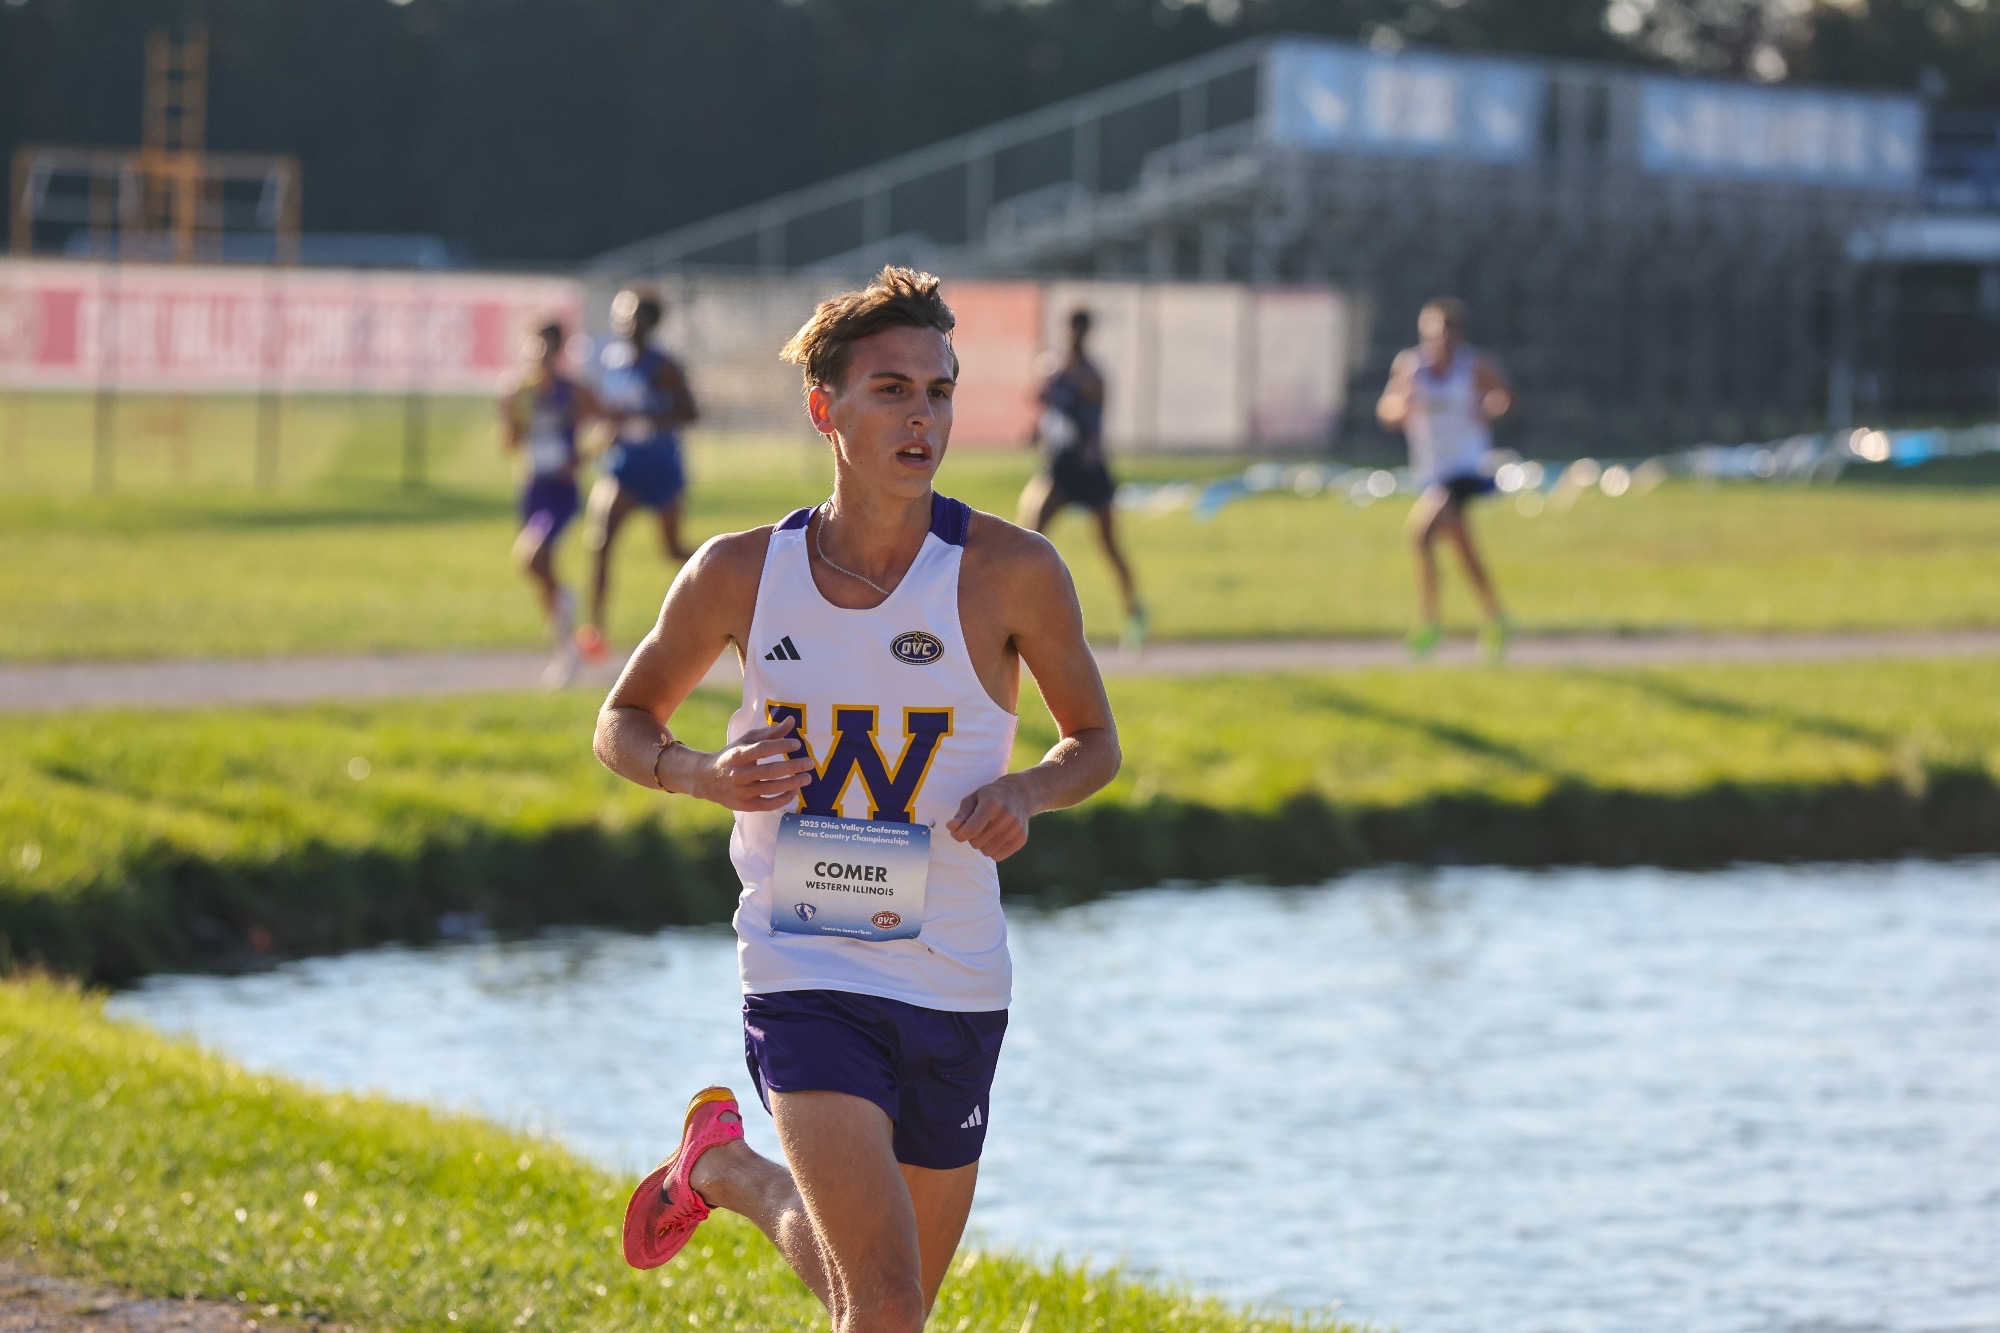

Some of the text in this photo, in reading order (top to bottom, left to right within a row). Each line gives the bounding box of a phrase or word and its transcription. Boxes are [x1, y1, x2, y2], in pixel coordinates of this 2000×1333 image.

[901, 642, 932, 656] OVC
[765, 698, 954, 824] W
[800, 820, 909, 836] 2025 Ohio Valley Conference
[798, 830, 909, 846] Cross Country Championships
[814, 861, 888, 883] COMER
[806, 880, 894, 896] WESTERN ILLINOIS
[877, 917, 895, 925] OVC
